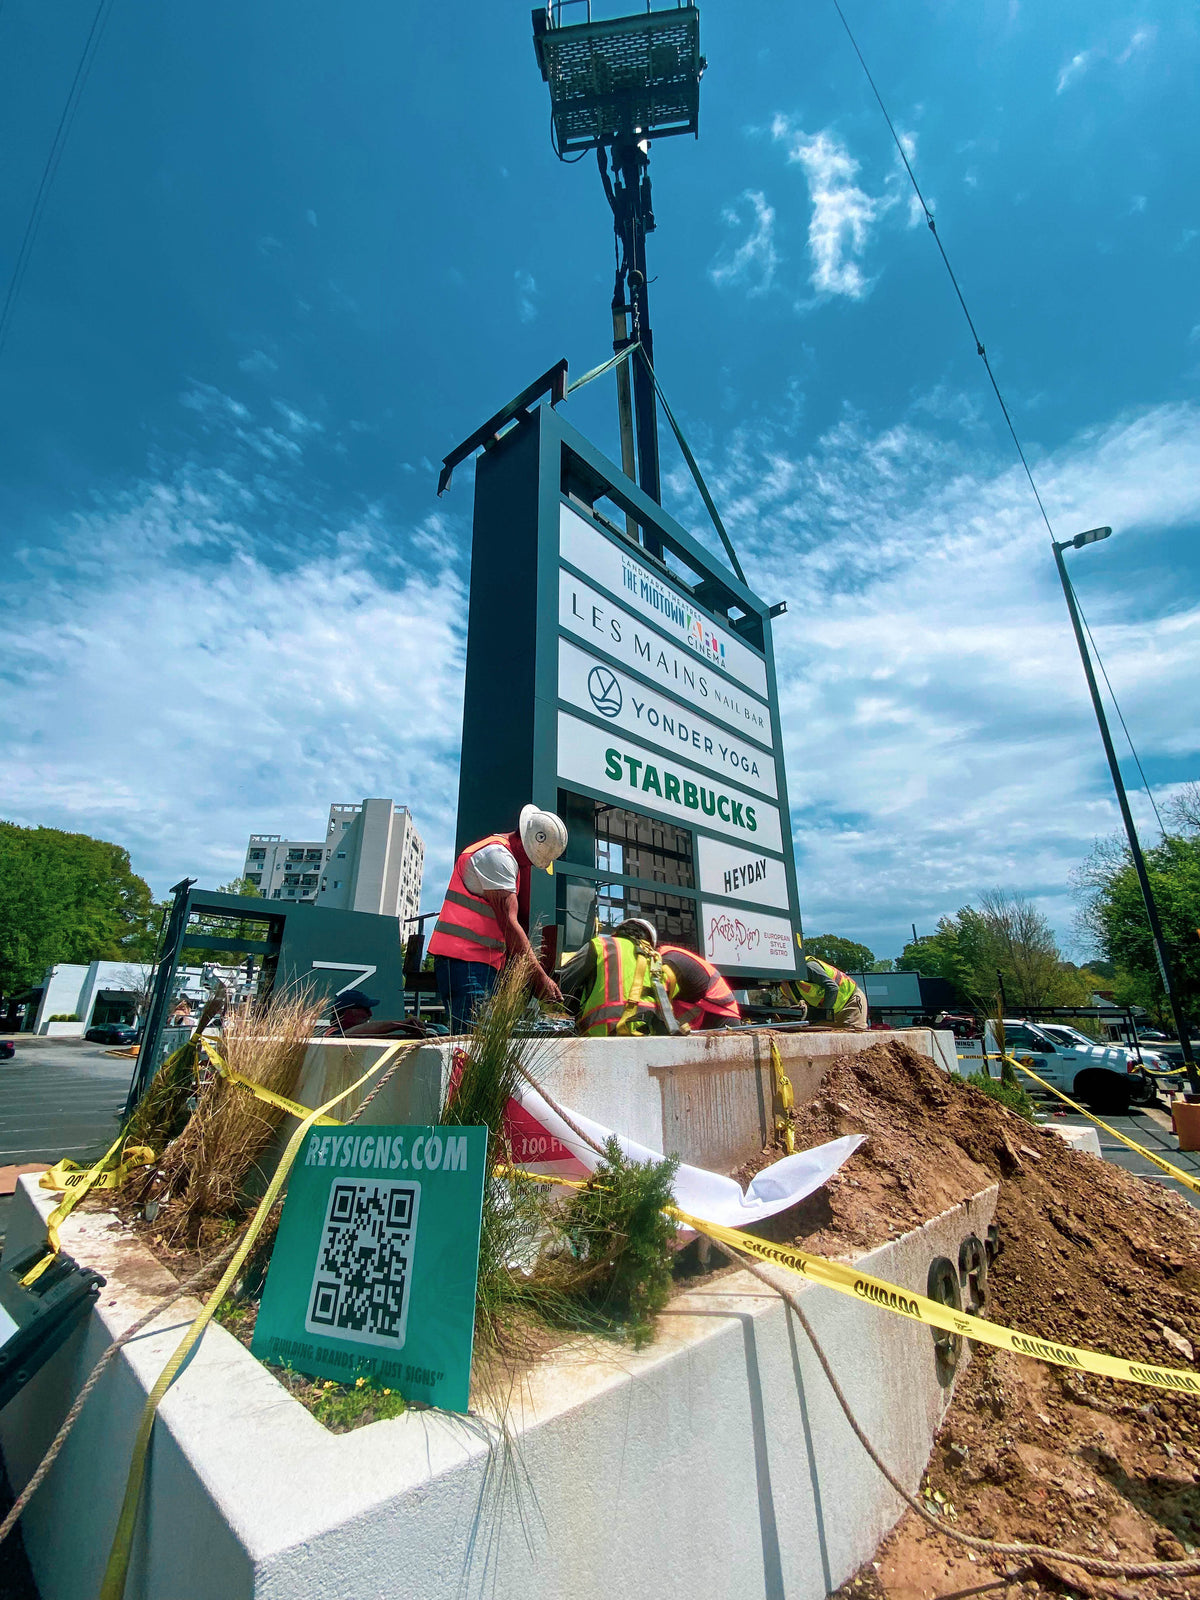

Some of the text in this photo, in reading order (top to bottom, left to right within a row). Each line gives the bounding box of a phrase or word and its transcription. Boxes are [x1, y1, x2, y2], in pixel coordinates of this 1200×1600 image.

[621, 554, 664, 593] LANDMARK
[622, 565, 638, 595] THE
[640, 578, 685, 629] MIDTOWN
[572, 592, 765, 729] LES MAINS NAIL BAR
[687, 635, 727, 669] CINEMA
[631, 697, 760, 779] YONDER YOGA
[604, 747, 758, 832] STARBUCKS
[723, 858, 768, 894] HEYDAY
[763, 931, 791, 942] EUROPEAN
[769, 948, 788, 957] BISTRO
[770, 940, 787, 949] STYLE
[304, 1134, 468, 1171] REYSIGNS.COM
[521, 1136, 548, 1155] 100
[742, 1240, 808, 1274] CAUTION
[853, 1279, 922, 1319] CUIDADO
[1010, 1334, 1086, 1369] CAUTION
[380, 1359, 404, 1380] JUST
[1128, 1365, 1200, 1392] CUIDADO
